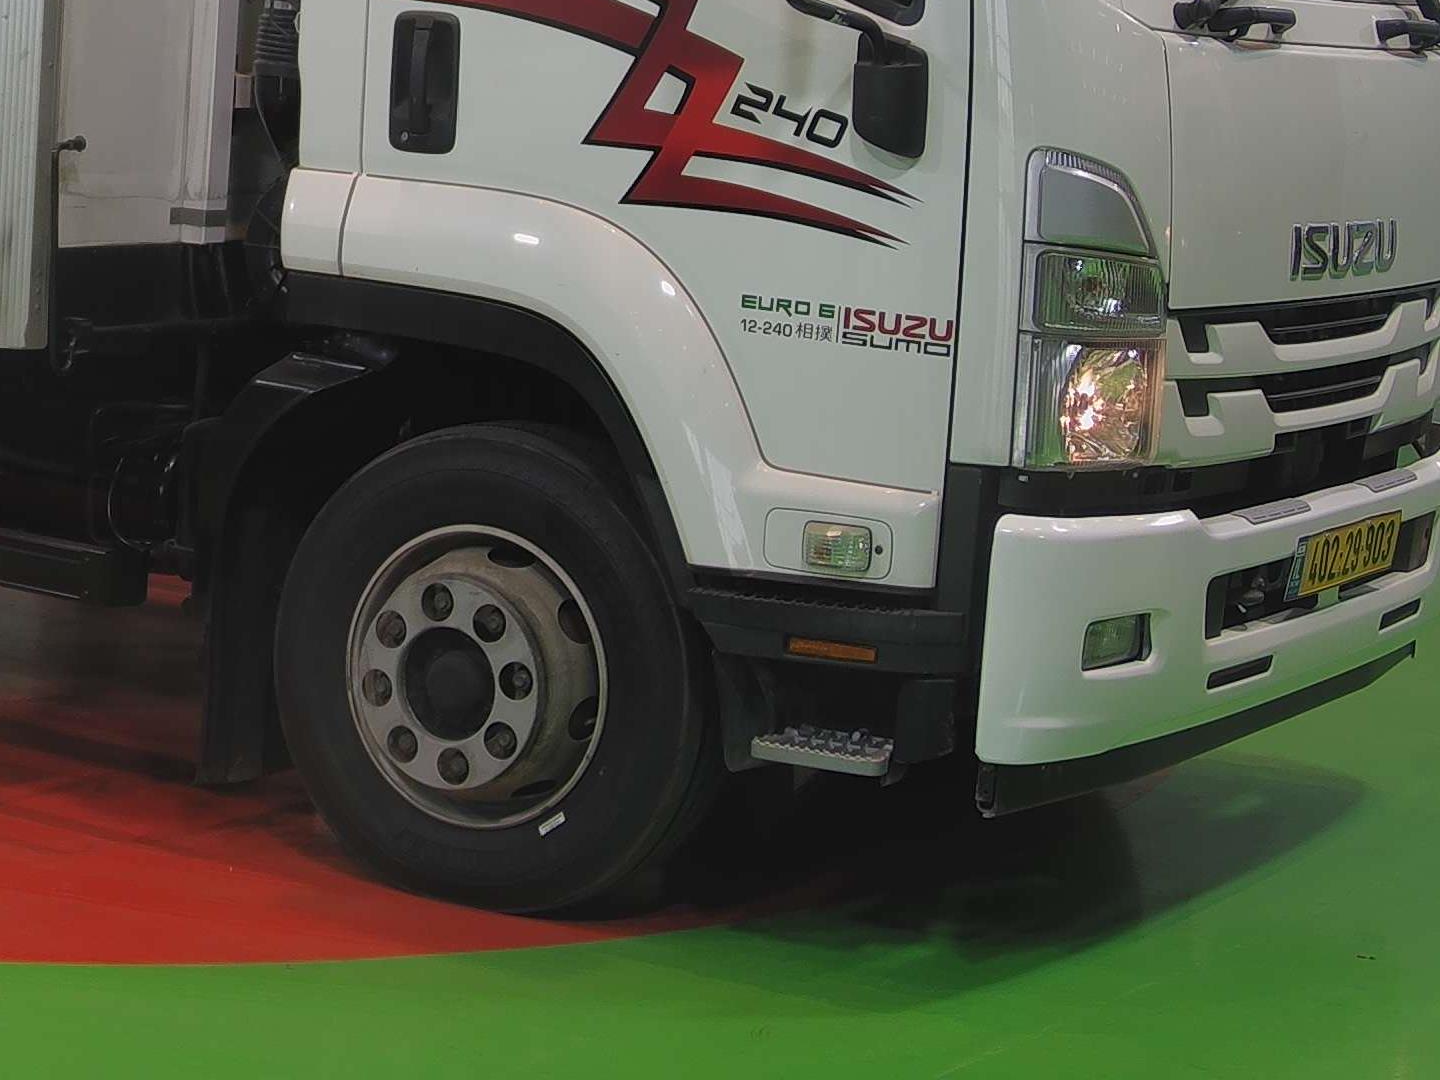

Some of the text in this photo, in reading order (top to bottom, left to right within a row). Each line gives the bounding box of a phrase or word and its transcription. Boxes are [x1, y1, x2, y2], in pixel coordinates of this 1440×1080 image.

[730, 81, 848, 148] 240
[1289, 218, 1397, 282] ISUZU
[741, 294, 835, 318] EURO 6
[739, 318, 793, 338] 12-240
[843, 306, 955, 342] ISUZU
[842, 331, 952, 357] SUMO
